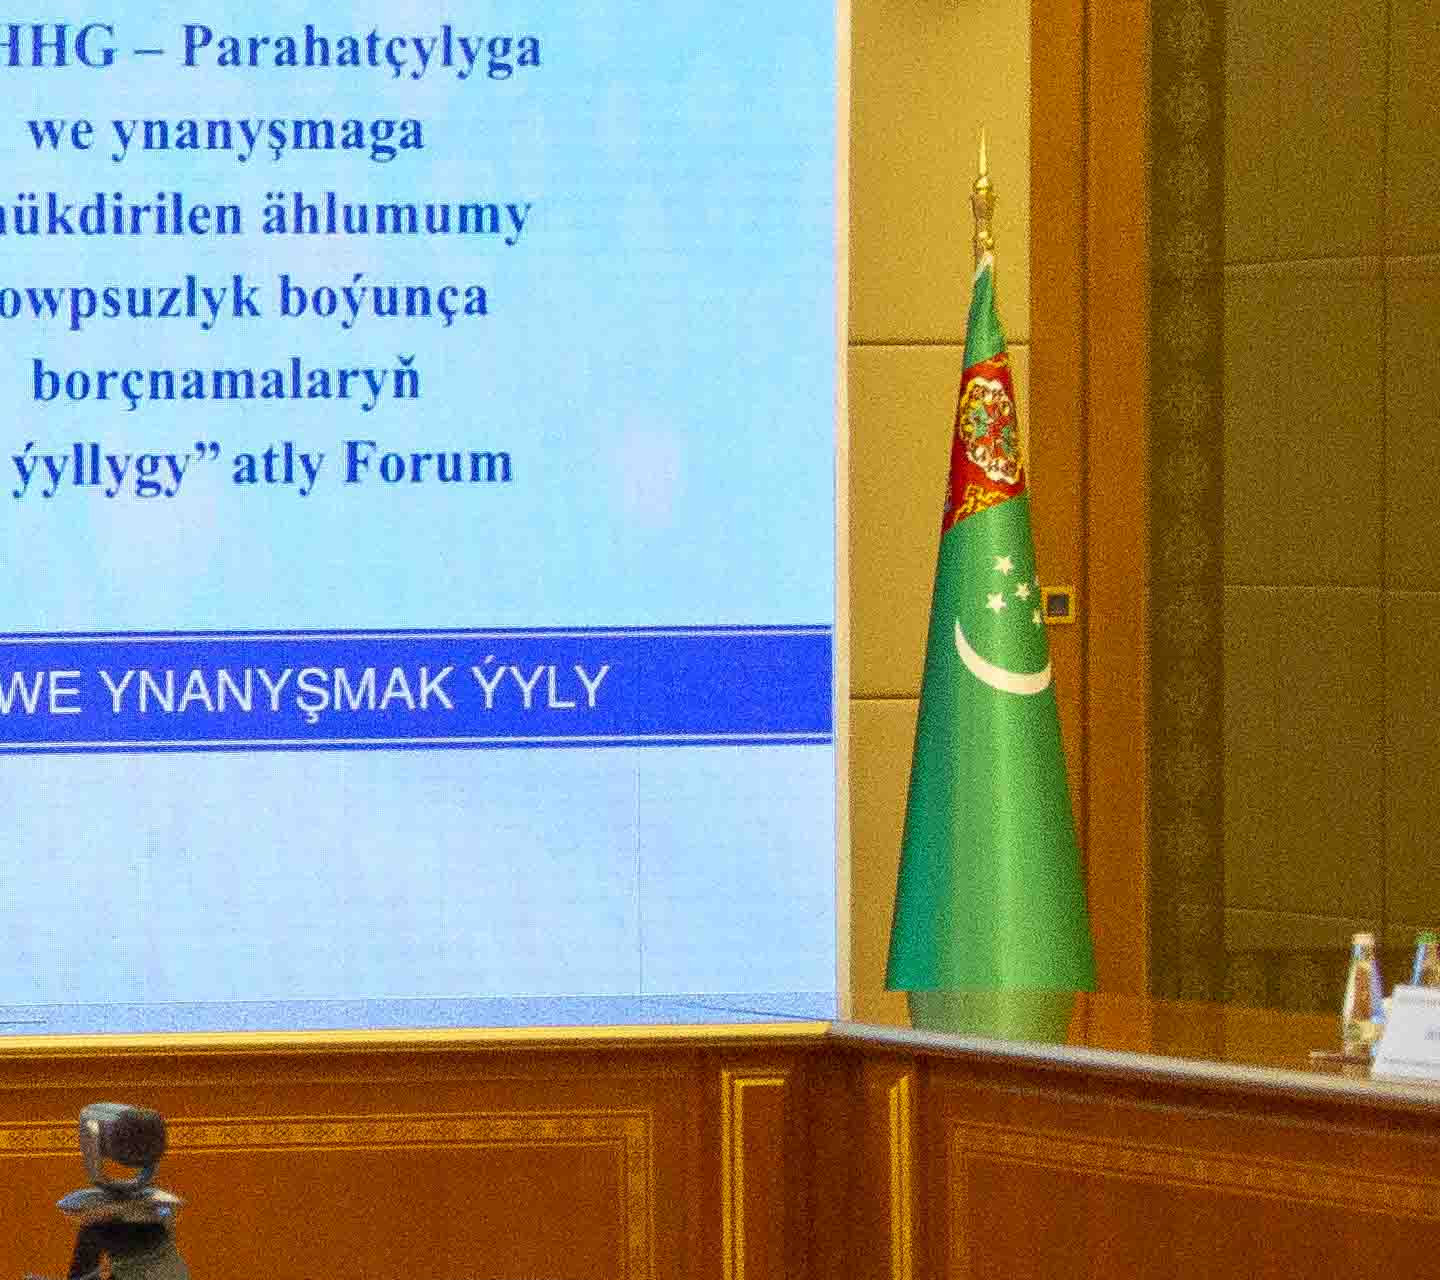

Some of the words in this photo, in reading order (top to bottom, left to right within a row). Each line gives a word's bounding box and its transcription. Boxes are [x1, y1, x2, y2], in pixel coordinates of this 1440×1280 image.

[185, 24, 541, 79] Parahatçylyga
[28, 120, 93, 150] we
[112, 119, 424, 162] ynanyşmaga
[263, 192, 532, 246] ählumumy
[281, 274, 488, 329] boýunça
[33, 357, 420, 412] borçnamalaryň
[233, 442, 326, 496] atly
[346, 440, 512, 483] Forum
[100, 666, 453, 724] YNANYŞMAK
[471, 655, 609, 709] ÝYLY
